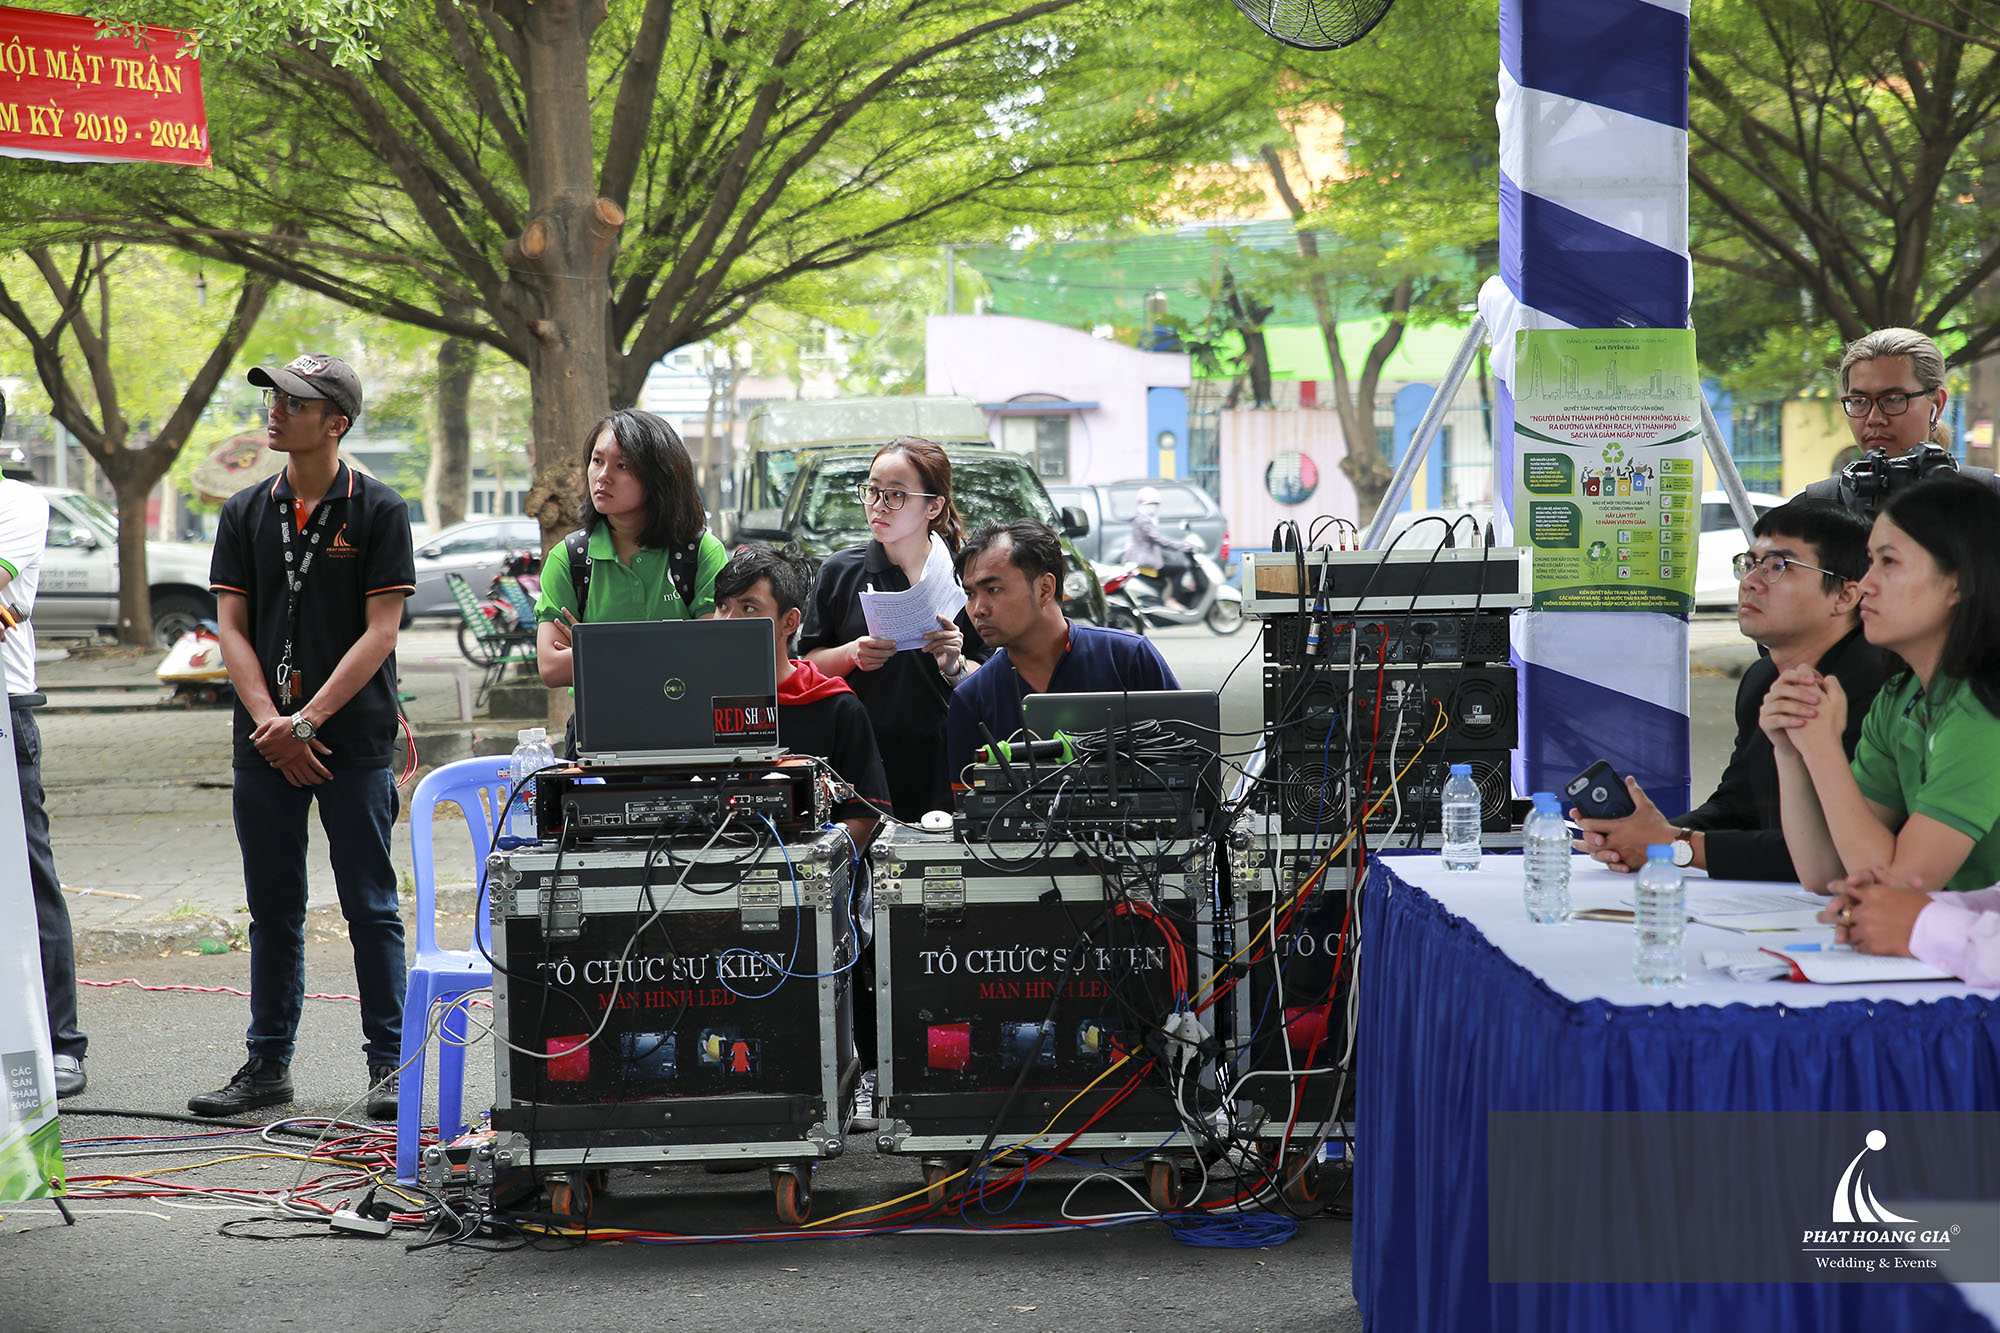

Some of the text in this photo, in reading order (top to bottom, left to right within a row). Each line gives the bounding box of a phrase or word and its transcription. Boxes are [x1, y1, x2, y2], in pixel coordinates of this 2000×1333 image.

[44, 44, 105, 90] MẶT
[111, 55, 182, 99] TRẬN
[27, 98, 65, 138] KỲ
[75, 112, 128, 144] 2019
[135, 131, 143, 139] -
[151, 120, 202, 150] 2024
[1556, 413, 1570, 422] DÂN
[1571, 413, 1594, 422] THÀNH
[1595, 413, 1609, 422] PHỐ
[1610, 413, 1619, 422] HỒ
[1621, 413, 1632, 422] CHÍ
[1633, 413, 1650, 422] MINH
[1651, 413, 1672, 422] KHÔNG
[1673, 413, 1680, 422] XẢ
[1570, 432, 1588, 440] SẠCH
[1589, 431, 1598, 439] VÀ
[1599, 431, 1615, 439] GIẢM
[1616, 431, 1635, 440] NGẬP
[714, 707, 776, 733] RED SHOW
[536, 951, 786, 985] TỔ CHỨC SỰ KIỆN
[919, 944, 1165, 975] TỔ CHỨC SỰ KỆN
[598, 986, 737, 1010] MÀN HÌNH LED
[979, 977, 1020, 999] MÀN
[1025, 977, 1074, 998] HÌNH
[11, 1066, 32, 1076] CÁC
[12, 1099, 39, 1110] KHÁC
